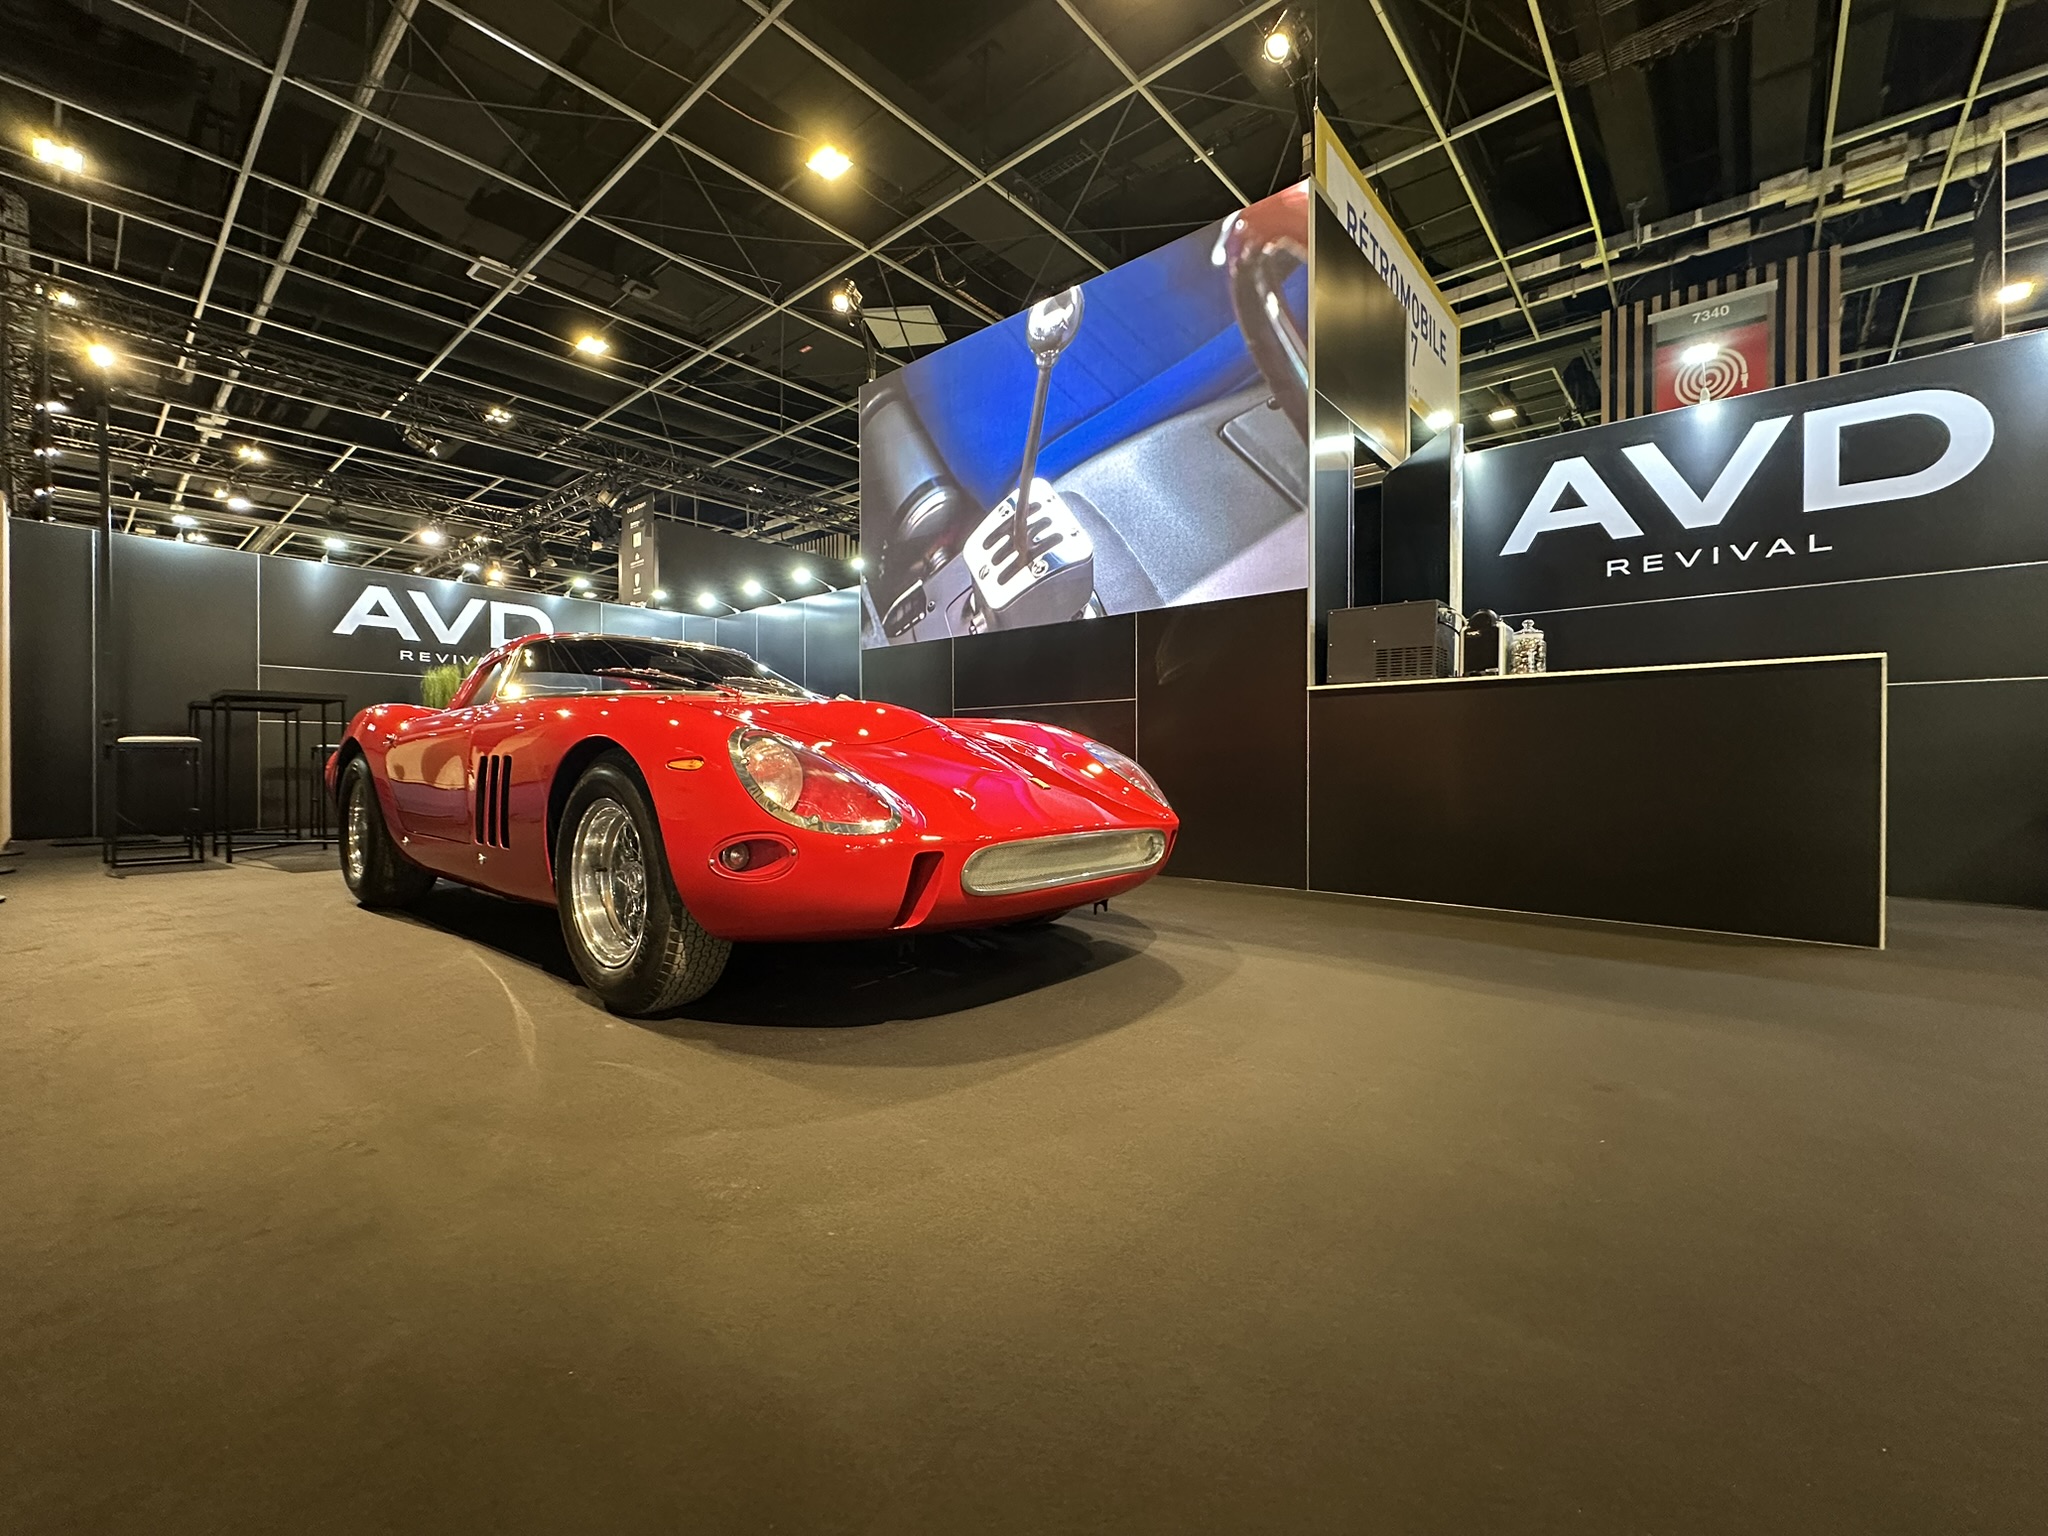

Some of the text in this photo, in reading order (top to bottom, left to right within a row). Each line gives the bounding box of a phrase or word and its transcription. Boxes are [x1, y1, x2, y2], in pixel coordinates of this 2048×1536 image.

[1346, 200, 1447, 367] RÉTROMOBILE
[1692, 305, 1730, 324] 7340
[1411, 330, 1418, 367] 7
[1499, 389, 1995, 556] AVD
[1606, 534, 1833, 577] REVIVAL
[332, 584, 555, 649] AVD
[400, 650, 484, 665] REVIV
